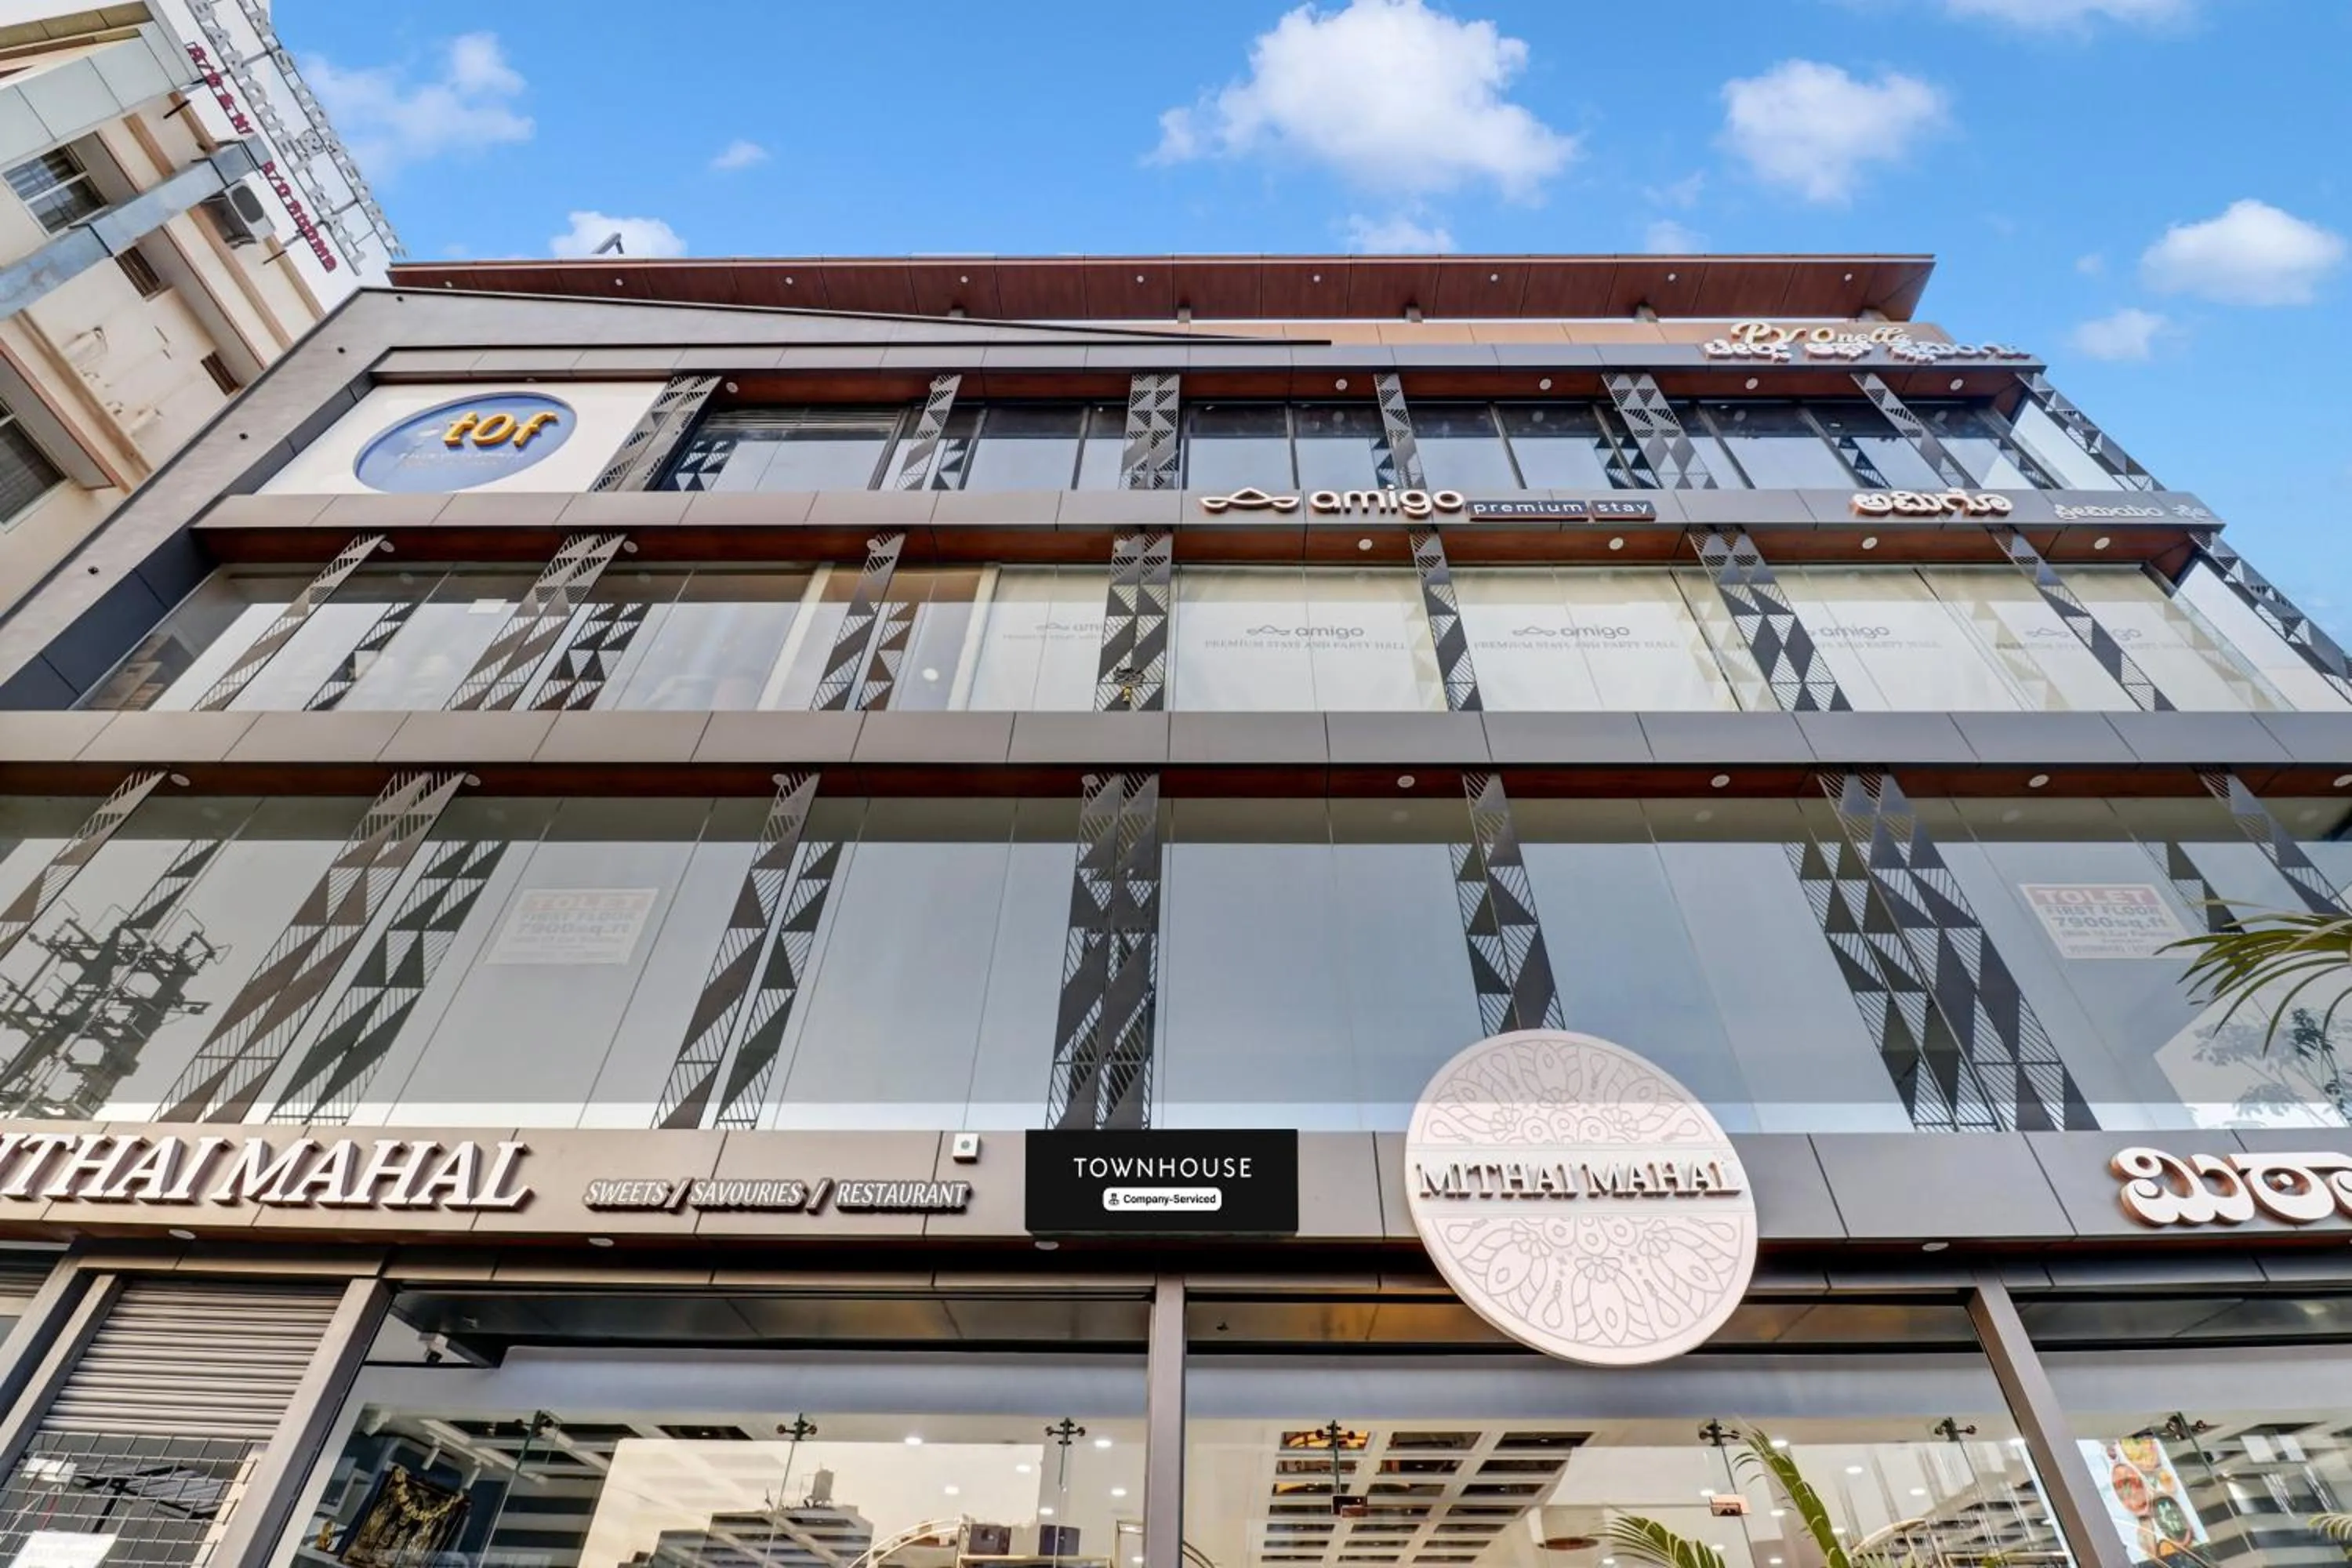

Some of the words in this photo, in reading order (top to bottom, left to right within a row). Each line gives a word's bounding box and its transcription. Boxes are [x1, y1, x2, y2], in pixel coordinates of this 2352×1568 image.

[187, 0, 312, 174] BANQUET
[307, 182, 367, 270] HALL
[1309, 485, 1465, 518] amigo
[1473, 500, 1584, 516] premium
[1596, 501, 1649, 517] stay
[1294, 625, 1365, 640] amigo
[1559, 625, 1630, 639] amigo
[1818, 625, 1890, 639] amigo
[1205, 639, 1263, 648] PREMIUM
[1334, 640, 1370, 650] PARTY
[210, 1136, 536, 1210] MAHAL
[1073, 1157, 1252, 1178] TOWNHOUSE
[1416, 1162, 1578, 1198] MITHAI
[1581, 1161, 1742, 1196] MAHAL
[584, 1180, 669, 1208] SWEETS
[688, 1180, 806, 1209] SAVOURIES
[835, 1181, 969, 1208] RESTAURANT
[1123, 1193, 1217, 1206] Company-Serviced
